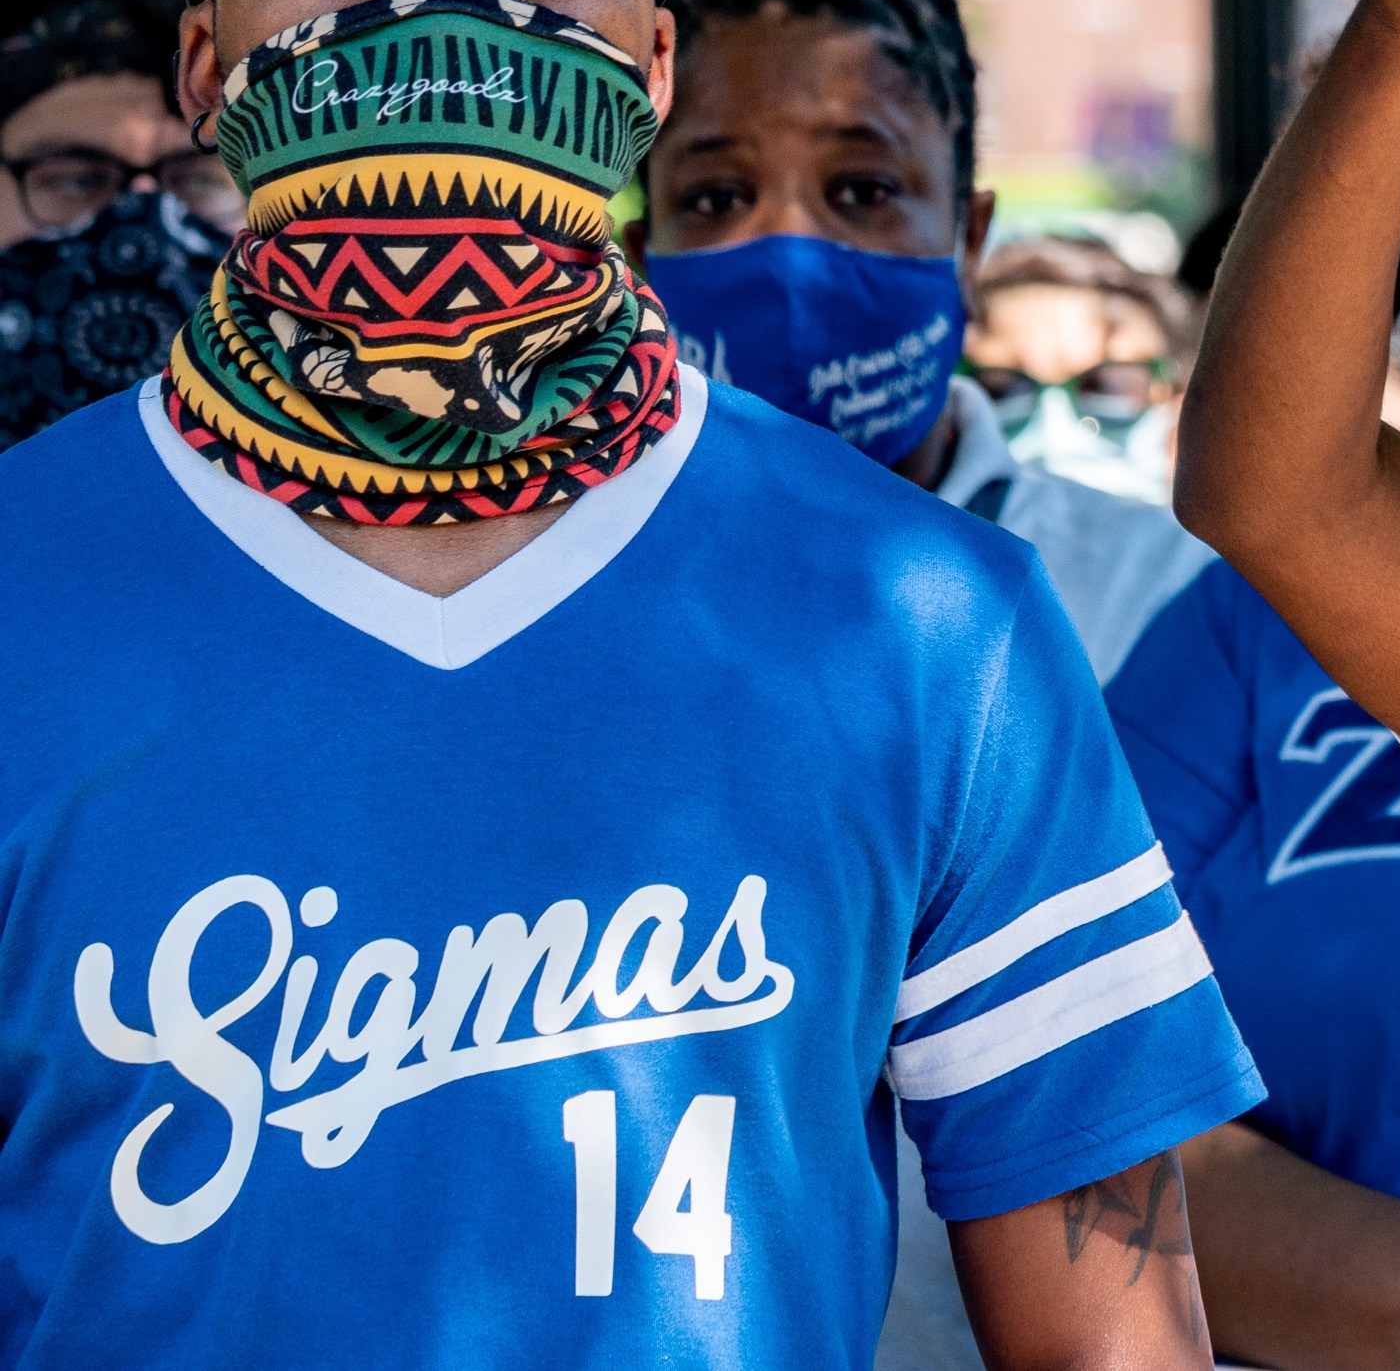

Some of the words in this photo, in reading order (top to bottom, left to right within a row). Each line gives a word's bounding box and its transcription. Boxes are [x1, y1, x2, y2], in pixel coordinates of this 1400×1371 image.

[291, 59, 528, 121] Crazygoodz
[73, 874, 795, 1245] Sigmas
[562, 1089, 737, 1304] 14
